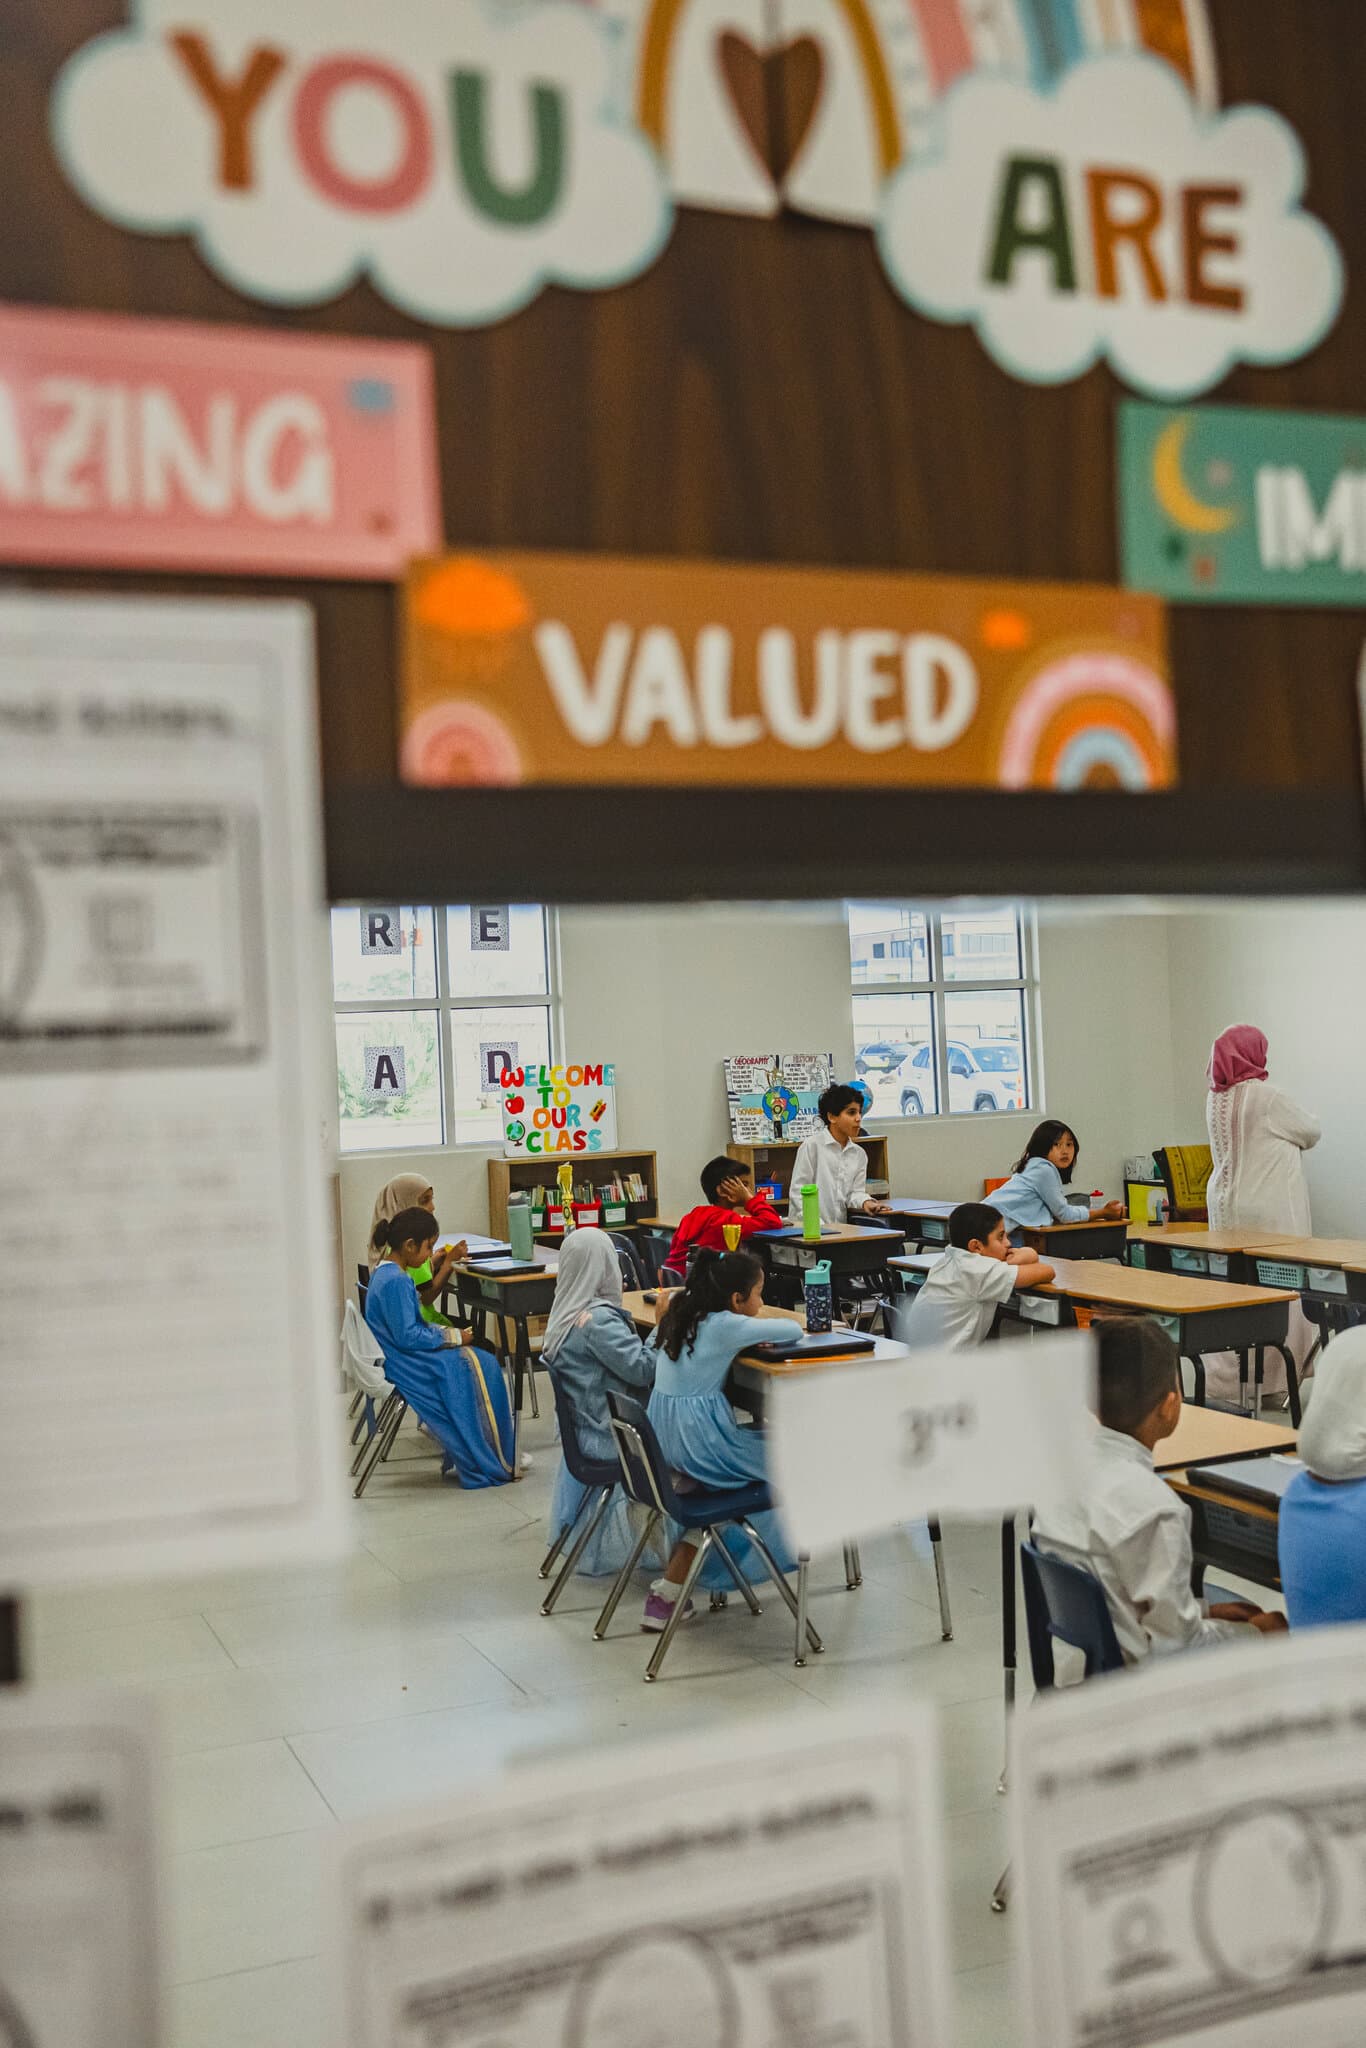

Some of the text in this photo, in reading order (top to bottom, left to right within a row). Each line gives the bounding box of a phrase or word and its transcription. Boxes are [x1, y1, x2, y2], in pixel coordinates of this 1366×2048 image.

[165, 26, 569, 229] YOU
[985, 153, 1245, 313] ARE
[0, 376, 334, 522] ZING
[535, 620, 979, 751] VALUED
[368, 912, 394, 947] R
[478, 909, 501, 943] E
[372, 1054, 399, 1089] A
[500, 1064, 615, 1088] WELCOME
[537, 1086, 571, 1108] TO
[532, 1104, 581, 1129] OUR
[526, 1129, 602, 1153] CLASS
